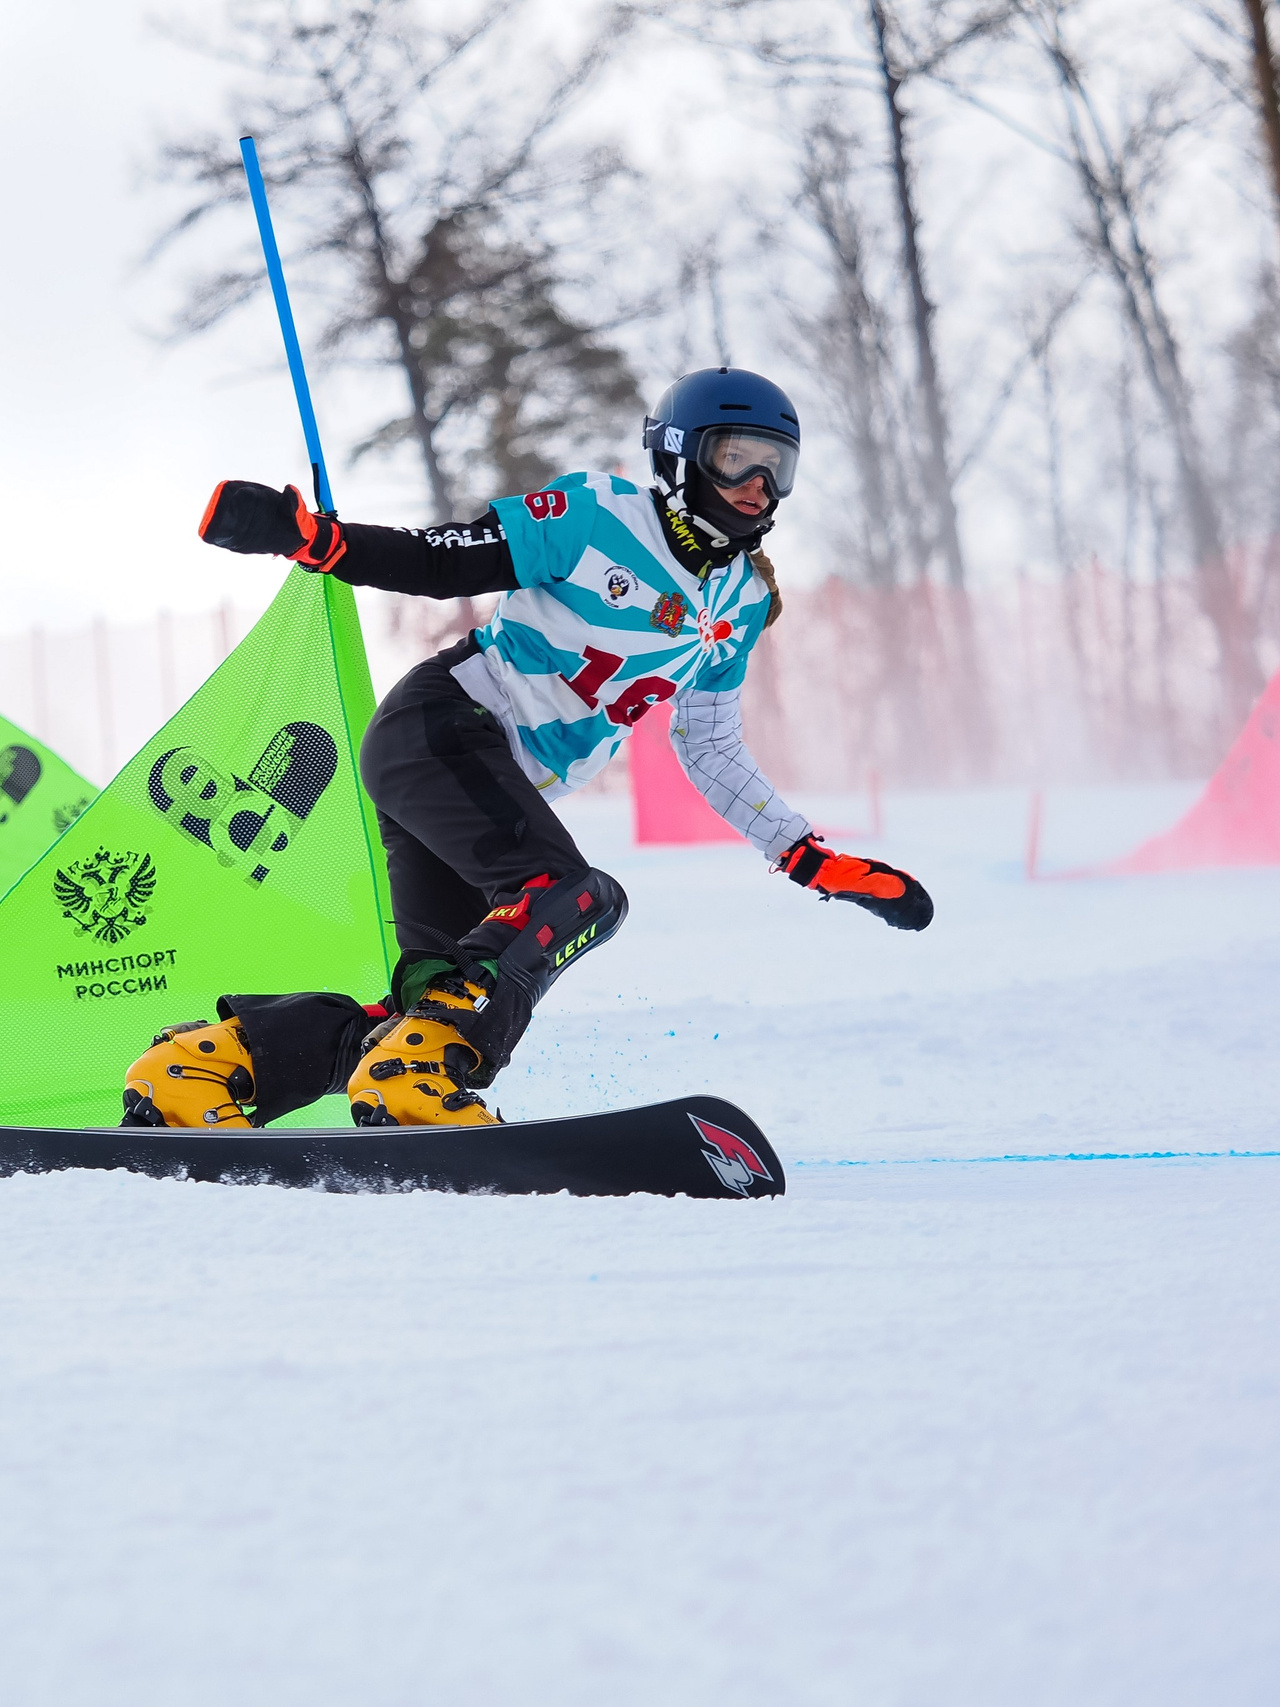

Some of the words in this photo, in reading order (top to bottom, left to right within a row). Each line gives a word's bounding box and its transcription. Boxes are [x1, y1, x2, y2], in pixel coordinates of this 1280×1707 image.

[558, 644, 677, 728] 16
[555, 922, 597, 967] LEKI
[56, 949, 177, 978] МИНСПОРТ
[75, 974, 167, 999] РОССИИ
